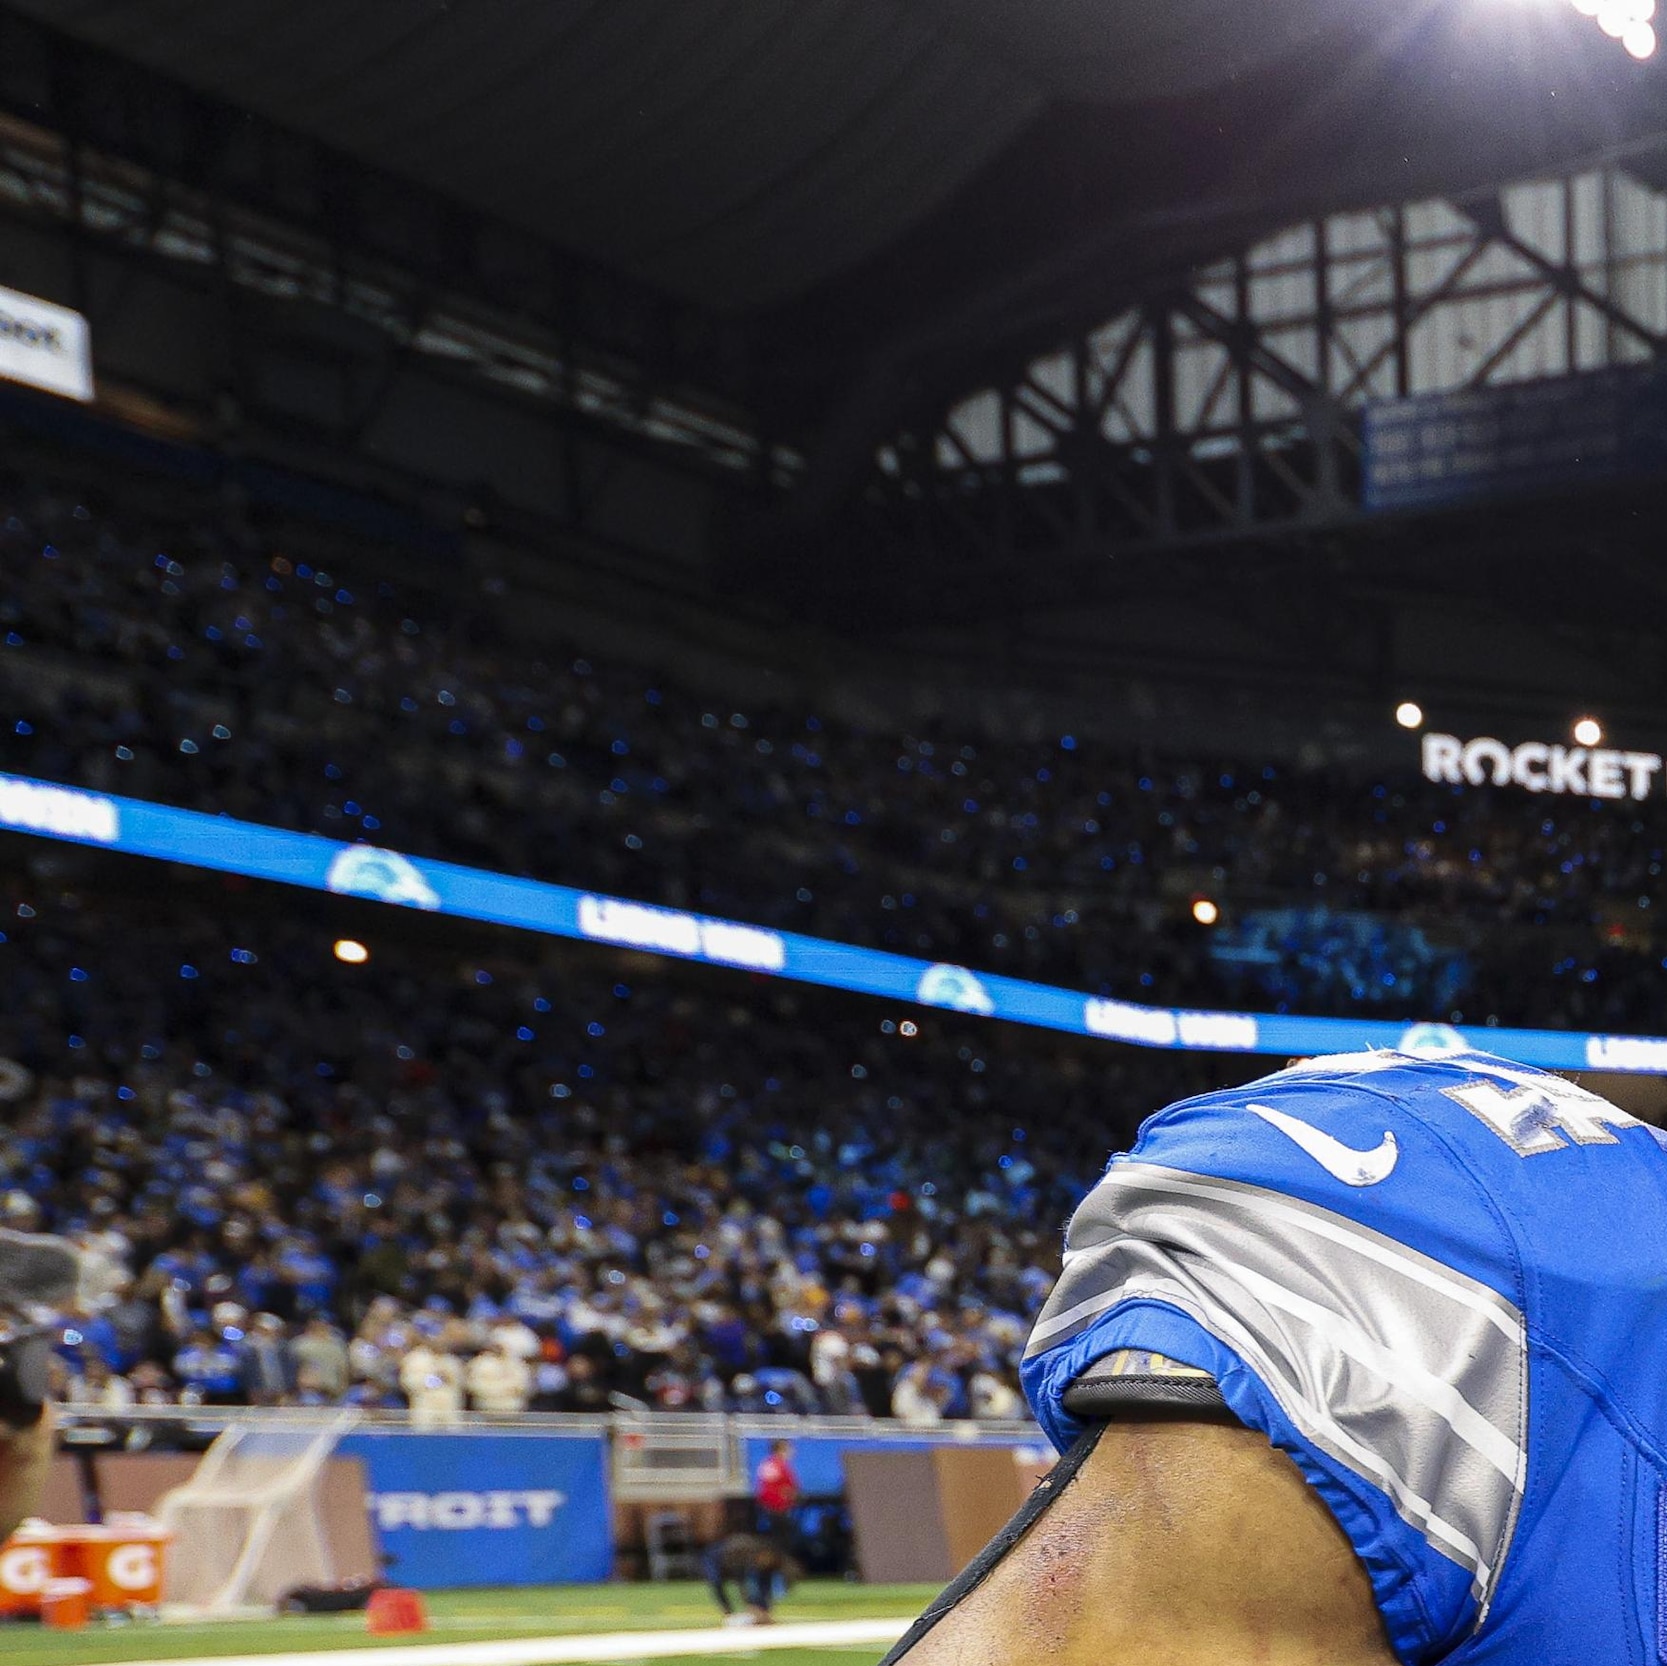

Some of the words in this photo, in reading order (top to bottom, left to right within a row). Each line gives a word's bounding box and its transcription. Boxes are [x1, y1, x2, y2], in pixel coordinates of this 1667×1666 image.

[1422, 733, 1662, 801] ROCKET
[365, 1489, 568, 1531] ROIT
[1, 1545, 48, 1596] G
[107, 1543, 156, 1591] G
